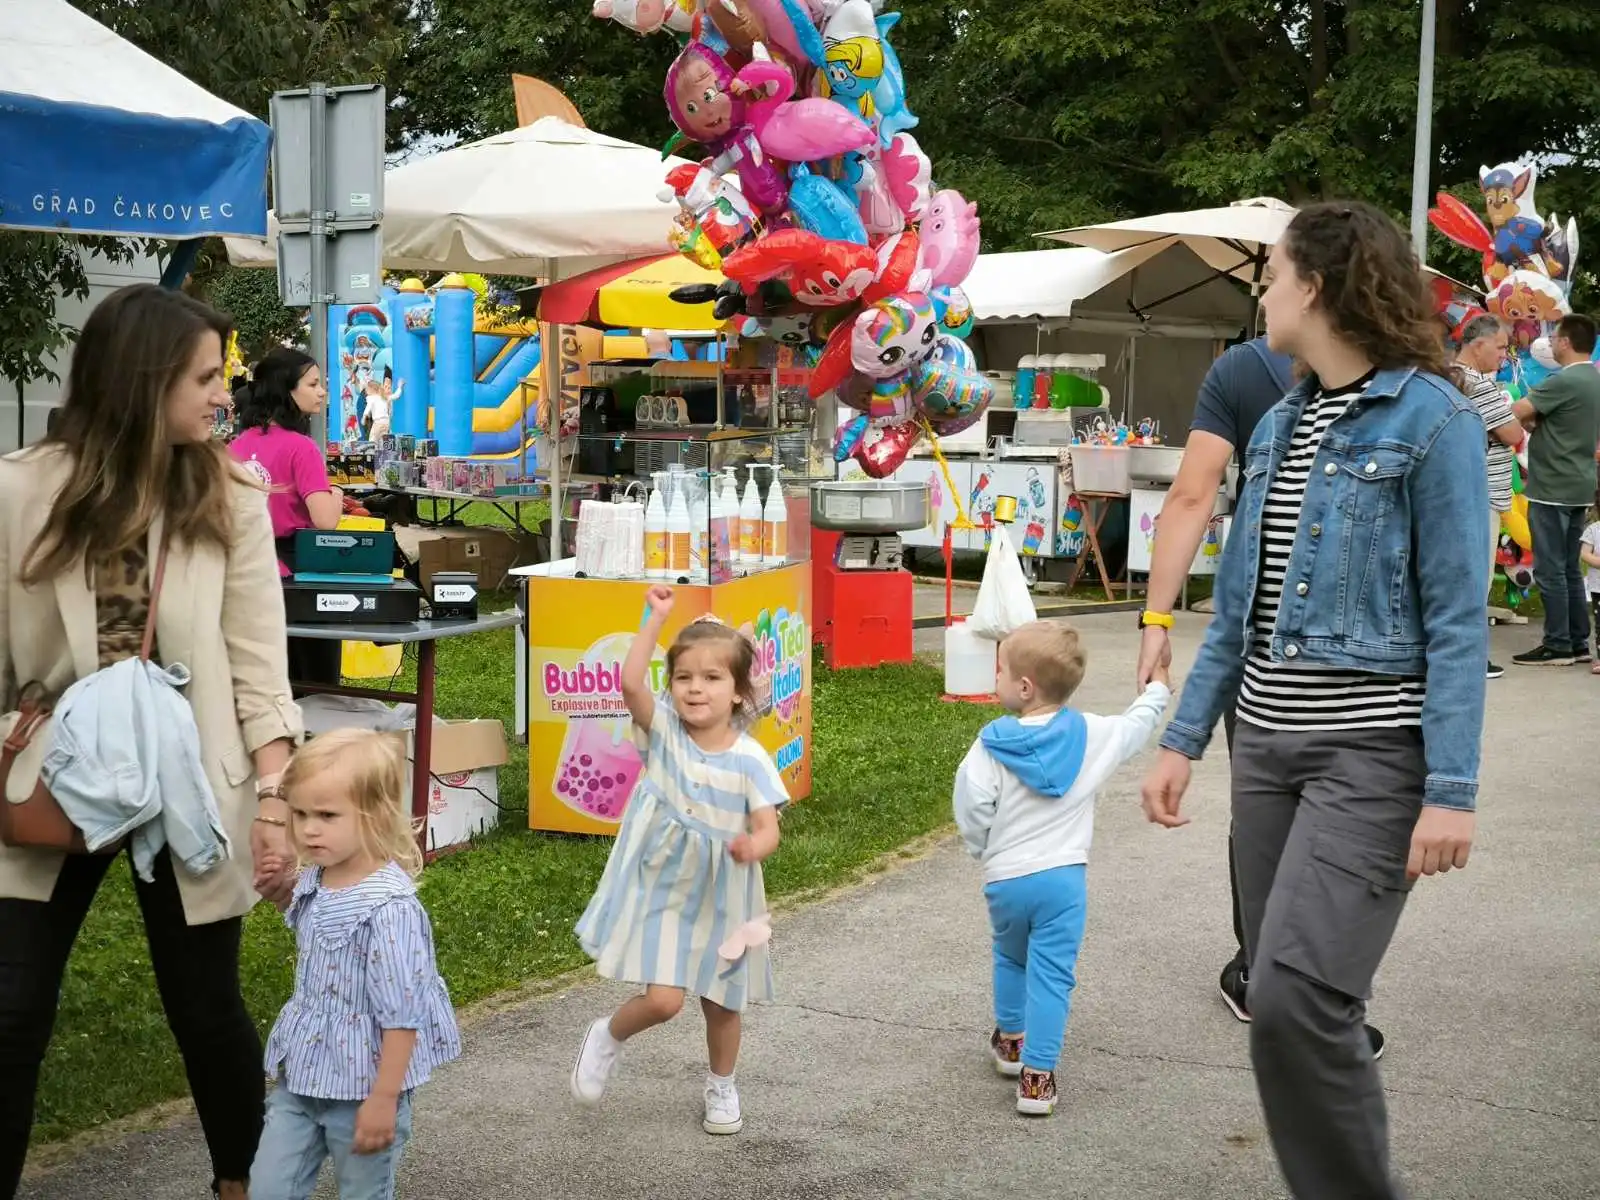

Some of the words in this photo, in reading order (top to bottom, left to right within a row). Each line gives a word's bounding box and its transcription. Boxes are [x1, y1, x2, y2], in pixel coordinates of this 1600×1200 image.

[32, 194, 96, 215] GRAD
[113, 195, 234, 221] ČAKOVEC
[778, 620, 804, 661] Tea
[543, 661, 622, 695] Bubbl
[772, 662, 802, 704] Italia
[551, 699, 599, 712] Explosive
